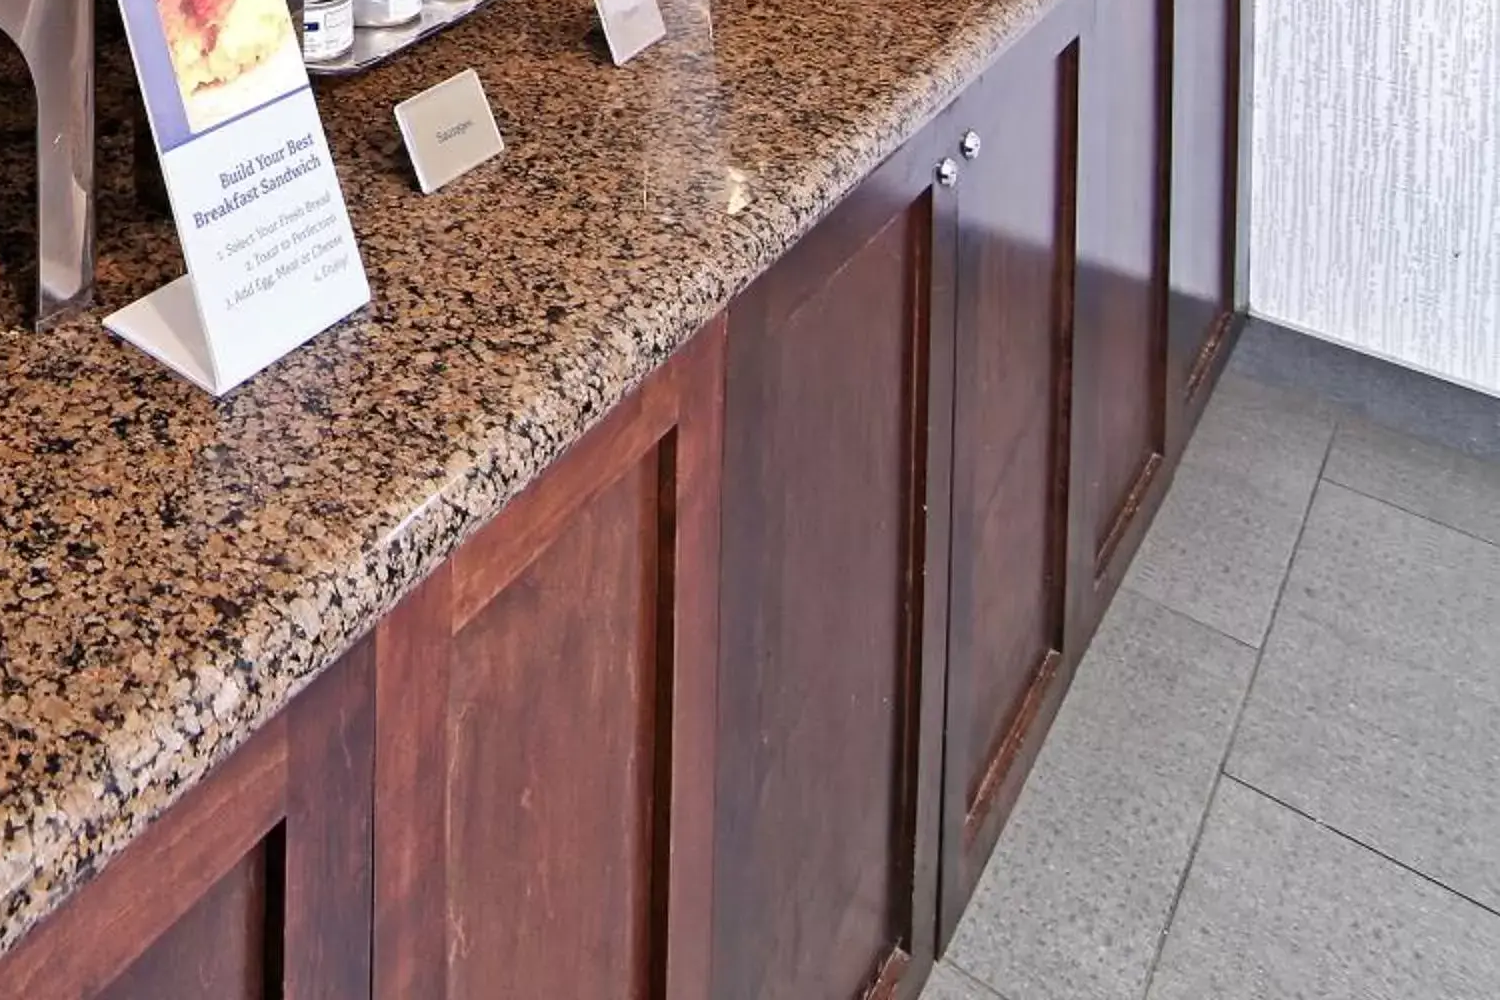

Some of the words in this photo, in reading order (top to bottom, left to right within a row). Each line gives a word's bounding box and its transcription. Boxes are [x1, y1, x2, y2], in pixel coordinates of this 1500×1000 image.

[192, 187, 259, 229] Breakfast
[260, 154, 321, 195] Sandwich
[219, 159, 256, 189] Build
[255, 148, 285, 171] Your
[286, 132, 314, 156] Best
